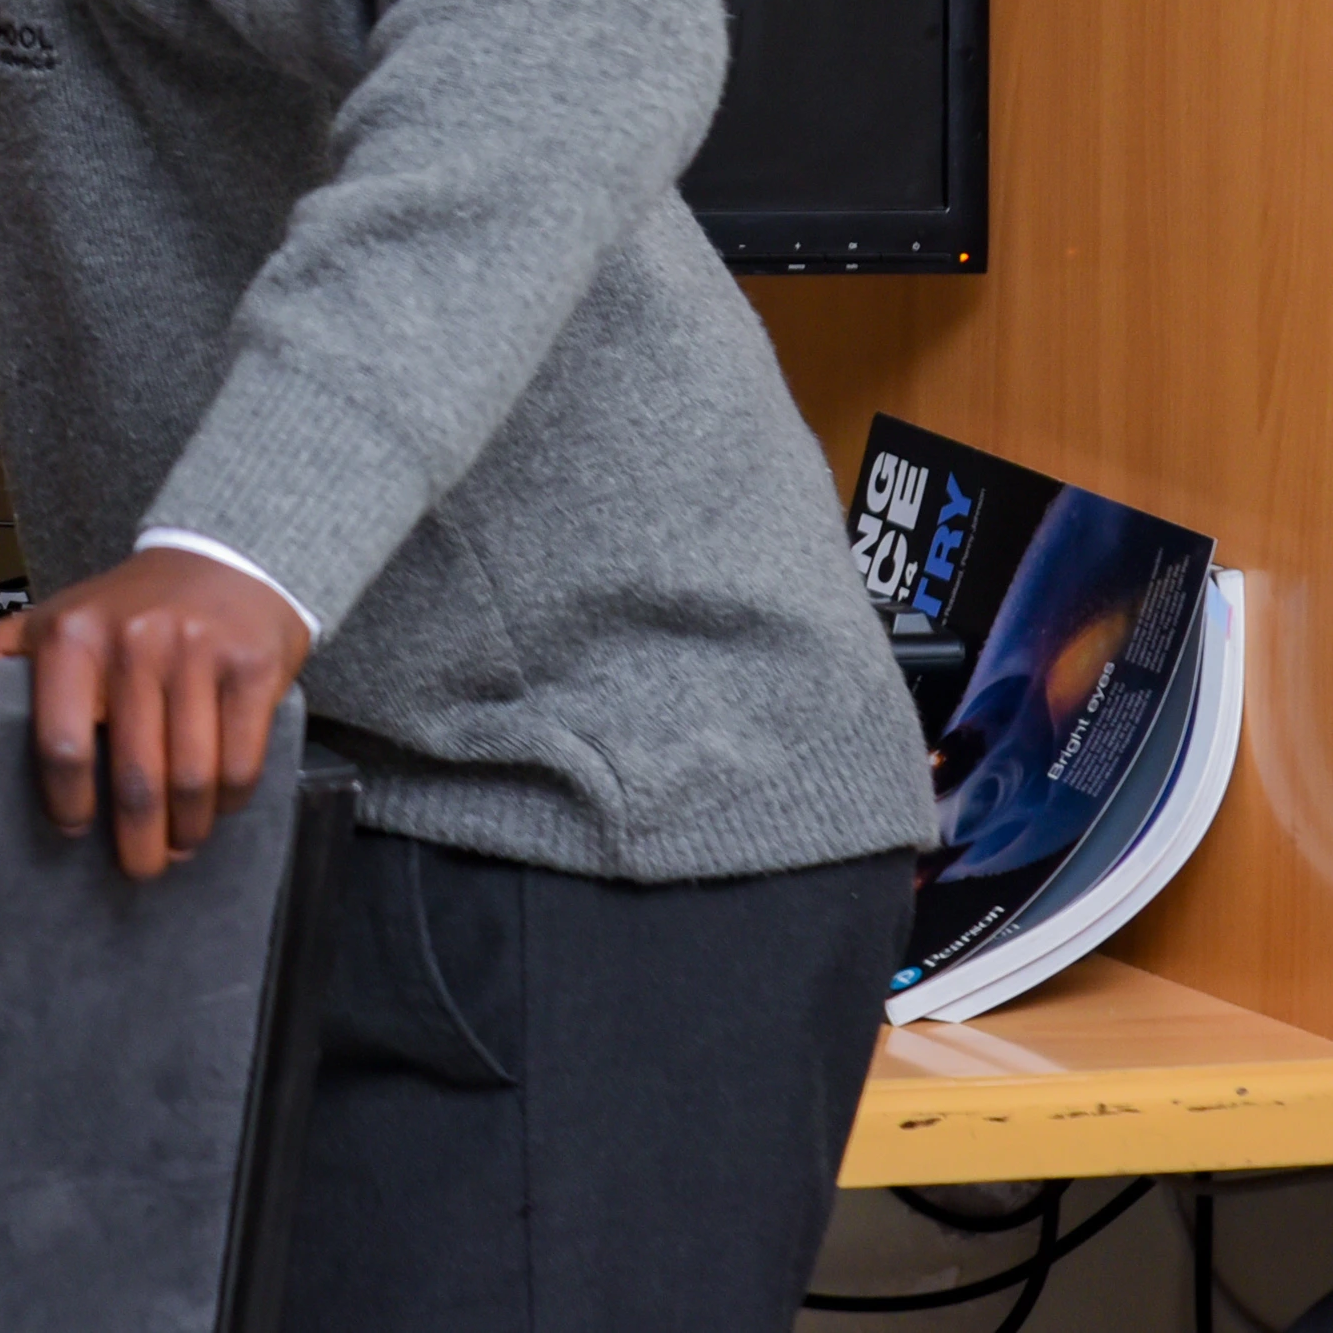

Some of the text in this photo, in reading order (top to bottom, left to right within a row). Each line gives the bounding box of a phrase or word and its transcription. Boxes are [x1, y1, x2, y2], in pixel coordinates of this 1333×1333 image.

[850, 450, 899, 574] NG
[865, 457, 930, 597] CE
[911, 470, 975, 619] TRY
[1045, 715, 1090, 781] Bright
[1085, 659, 1117, 713] eyes
[921, 903, 1006, 968] Pearson
